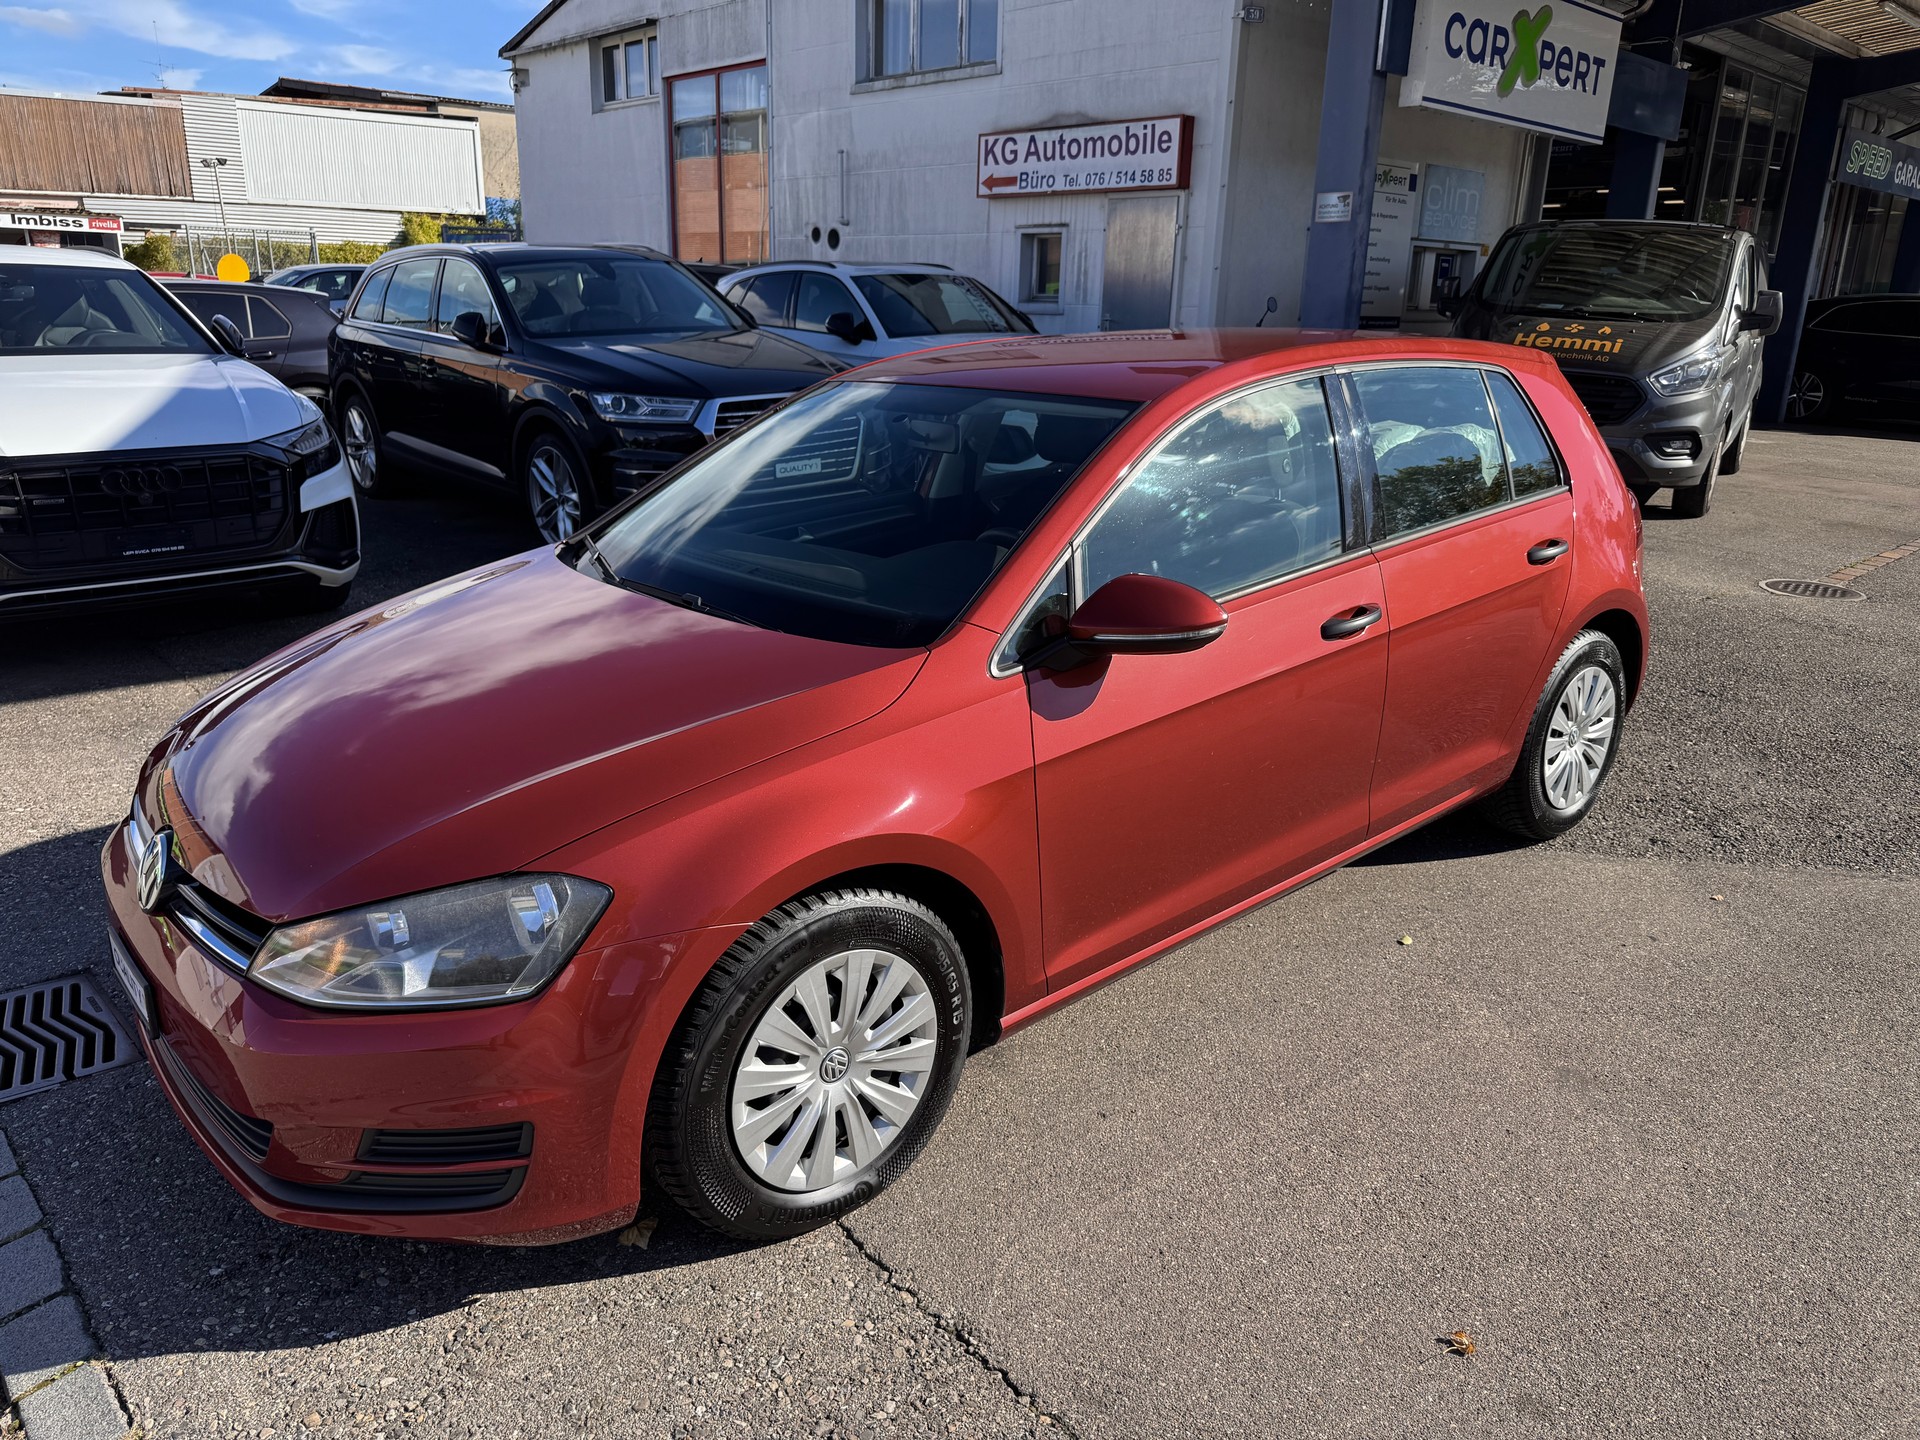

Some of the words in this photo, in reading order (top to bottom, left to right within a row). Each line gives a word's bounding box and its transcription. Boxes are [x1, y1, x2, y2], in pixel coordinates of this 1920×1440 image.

[983, 137, 1018, 166] KG
[1023, 123, 1173, 164] Automobile
[1846, 140, 1893, 180] SPEED
[1018, 171, 1056, 190] Büro
[1063, 174, 1081, 188] Tel.
[1084, 172, 1105, 186] 076
[1107, 171, 1113, 186] /
[1115, 170, 1136, 185] 514
[1139, 169, 1154, 184] 58
[1158, 167, 1173, 183] 85
[1426, 176, 1480, 215] clim
[10, 213, 84, 228] Imbiss
[91, 219, 119, 229] rivella
[1423, 211, 1477, 231] service
[1513, 332, 1624, 354] Hemmi
[1594, 355, 1610, 363] AG
[779, 463, 814, 474] QUALITY
